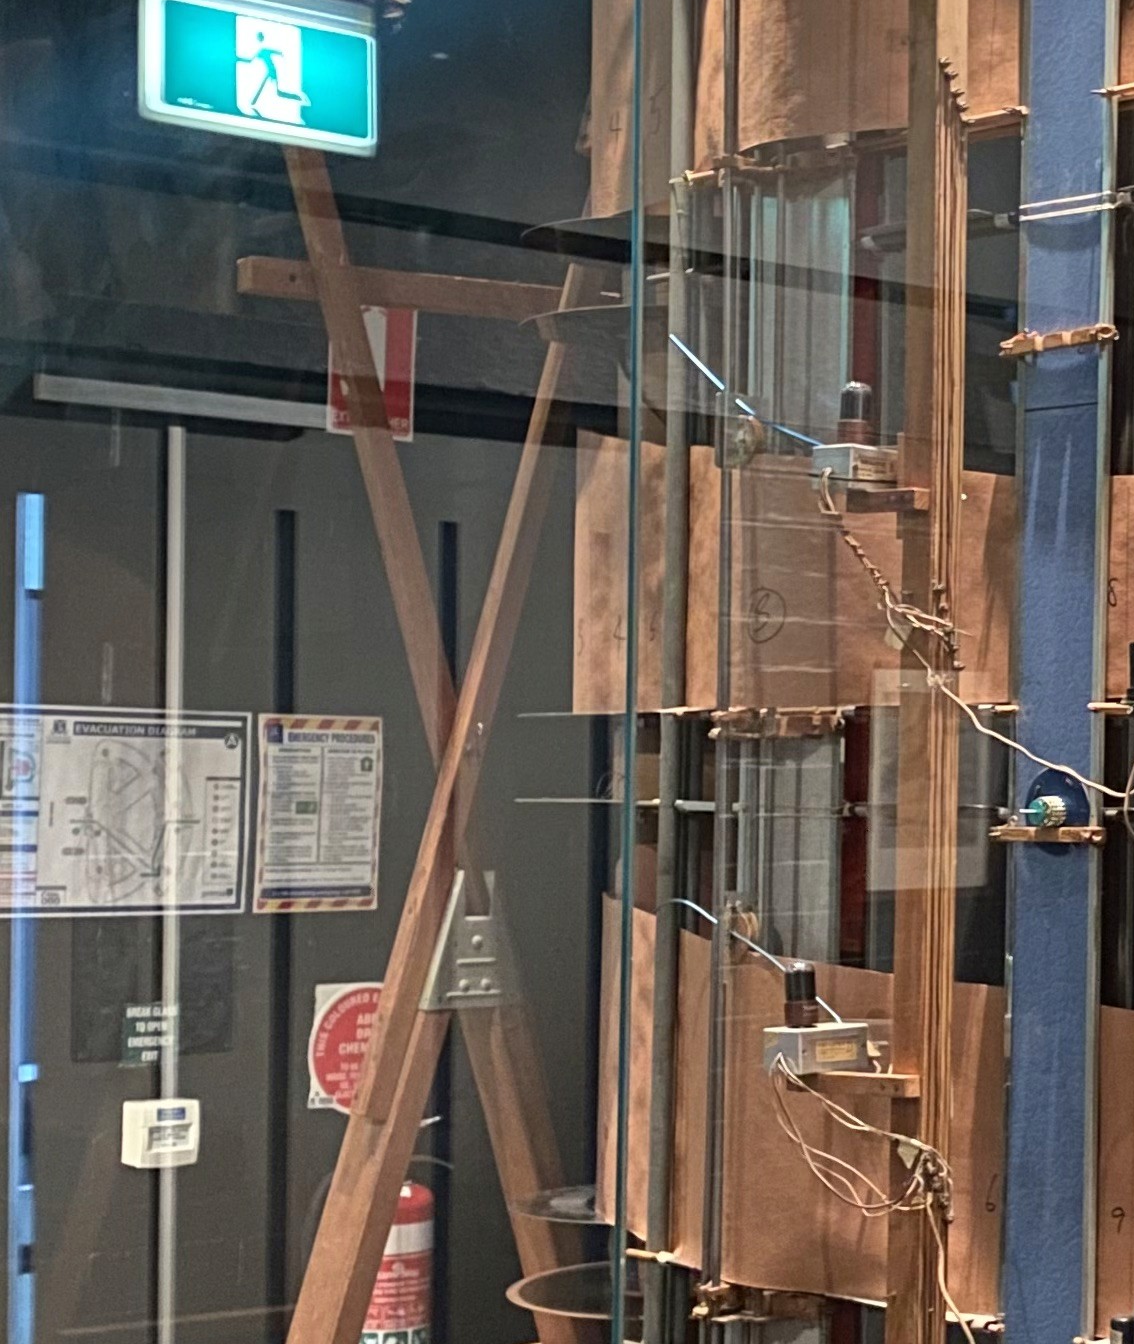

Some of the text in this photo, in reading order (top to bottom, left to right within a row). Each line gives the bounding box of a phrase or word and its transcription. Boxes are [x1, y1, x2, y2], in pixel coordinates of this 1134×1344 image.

[75, 722, 145, 735] EVACUATION
[985, 1173, 998, 1213] 6
[1111, 1207, 1126, 1234] 9
